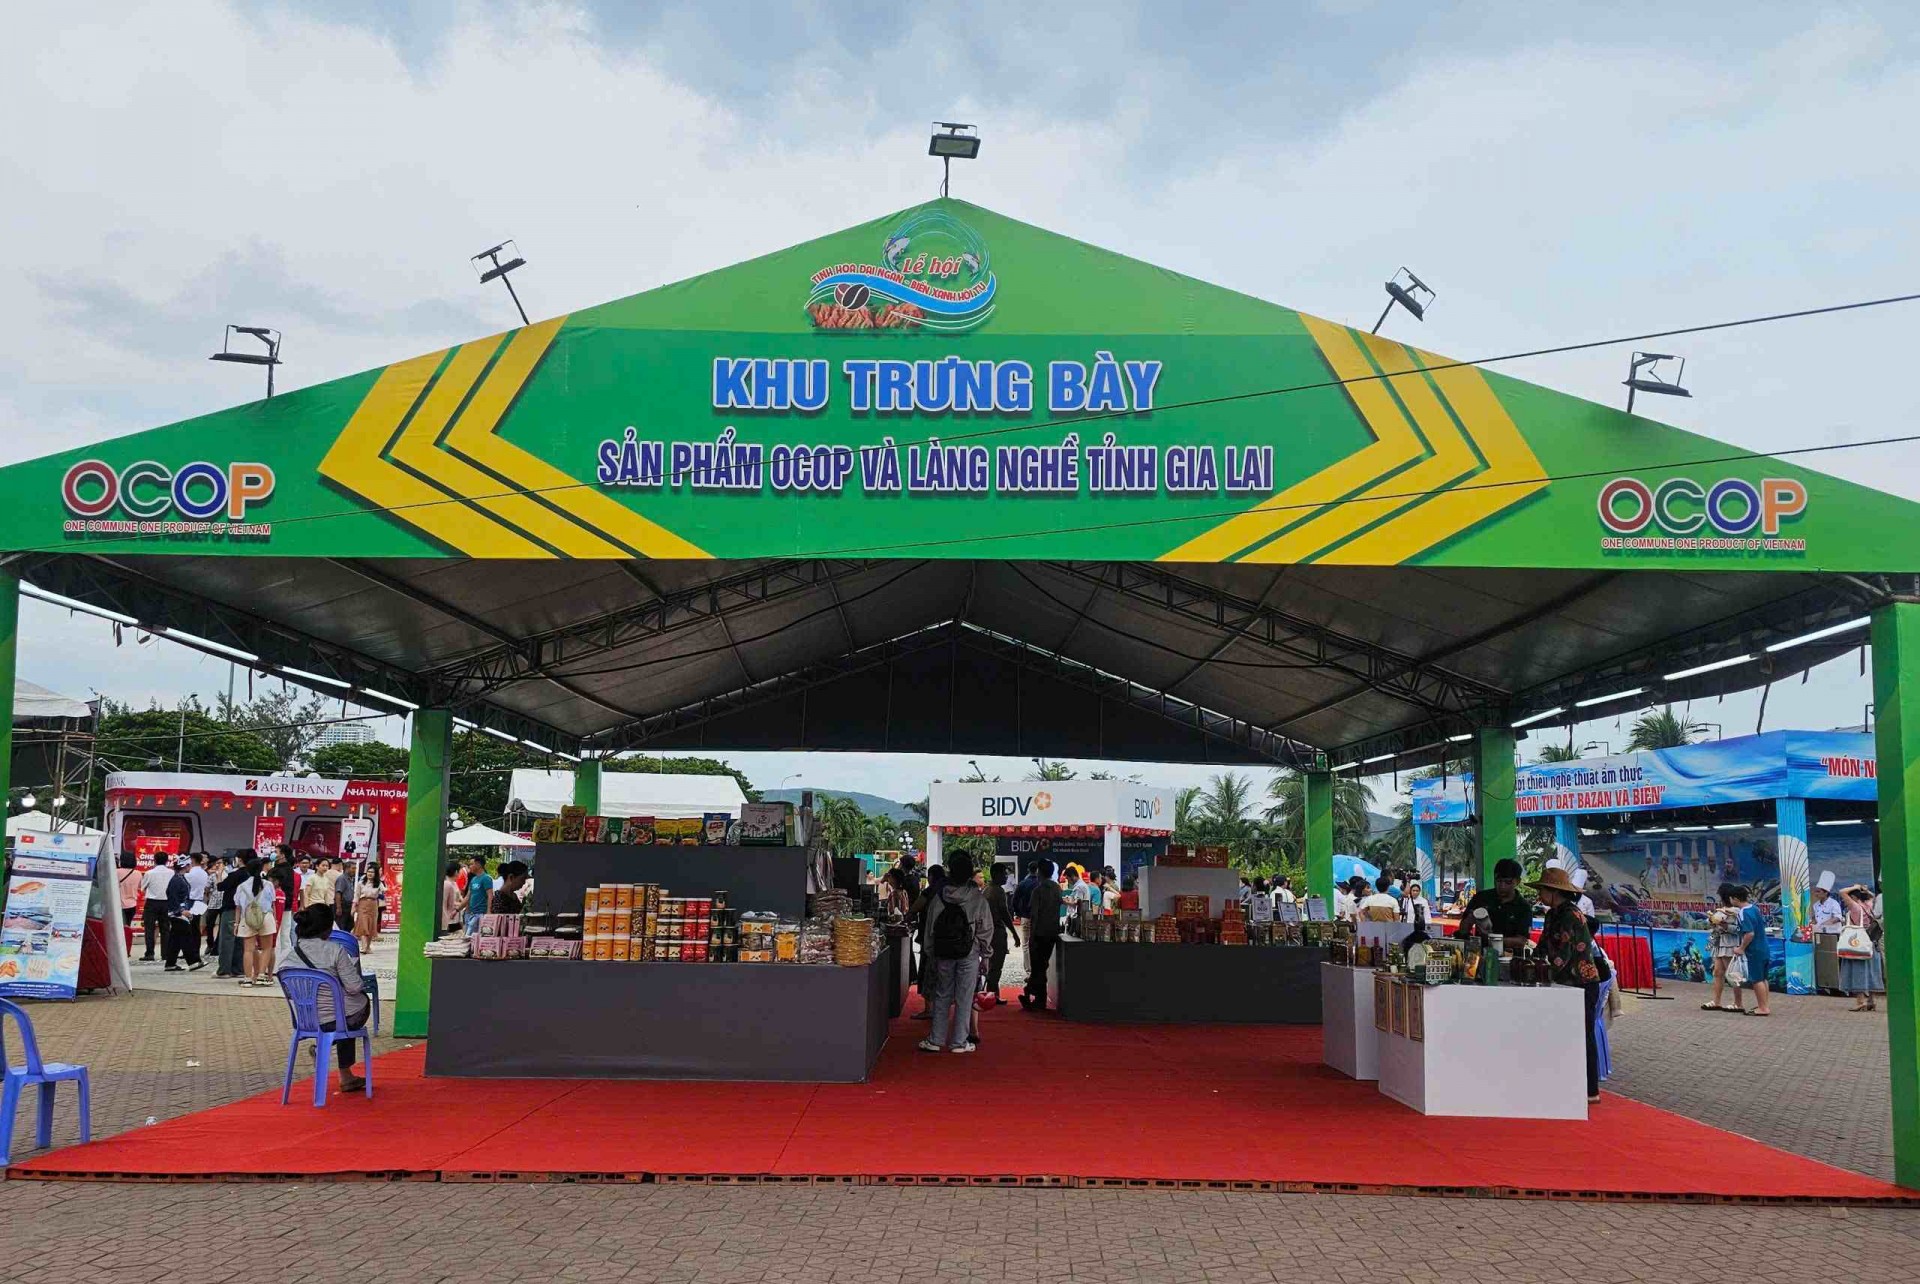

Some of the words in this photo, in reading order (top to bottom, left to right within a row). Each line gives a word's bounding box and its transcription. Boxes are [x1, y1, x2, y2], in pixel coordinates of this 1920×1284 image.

[901, 252, 928, 275] Lễ
[928, 255, 964, 278] hội
[811, 266, 834, 285] TINH
[835, 262, 858, 275] HOA
[931, 287, 958, 302] XANH
[713, 357, 830, 410] KHU
[843, 356, 1033, 412] TRƯNG
[1048, 351, 1162, 412] BÀY
[597, 425, 665, 486] SẢN
[671, 425, 763, 488] PHẨM
[769, 442, 855, 489] OCOP
[860, 436, 903, 491] VÀ
[907, 437, 990, 492] LÀNG
[996, 432, 1080, 492] NGHỀ
[1086, 431, 1158, 492] TỈNH
[1165, 445, 1219, 492] GIA
[1224, 445, 1274, 492] LAI
[61, 458, 277, 520] OCOP
[1597, 476, 1808, 535] OCOP
[63, 519, 86, 532] ONE
[87, 519, 138, 533] COMMUNE
[140, 520, 161, 533] ONE
[163, 521, 211, 534] PRODUCT
[212, 522, 226, 534] OF
[227, 523, 271, 535] VIETNAM
[1601, 537, 1622, 549] ONE
[1623, 537, 1675, 550] COMMUNE
[1676, 538, 1697, 550] ONE
[1698, 538, 1746, 550] PRODUCT
[1747, 538, 1761, 550] OF
[1762, 538, 1806, 551] VIETNAM
[1574, 767, 1599, 789] thuật
[1601, 762, 1617, 784] ẩm
[1619, 765, 1643, 785] thực
[1863, 759, 1878, 778] N
[260, 782, 336, 796] AGRIBANK
[346, 786, 365, 796] NHÀ
[366, 787, 379, 797] TÀI
[379, 788, 396, 799] TRỢ
[1577, 790, 1612, 809] BAZAN
[1615, 785, 1630, 807] VÀ
[982, 796, 1033, 817] BIDV
[1134, 798, 1155, 820] BIDV
[1011, 840, 1040, 853] BIDV
